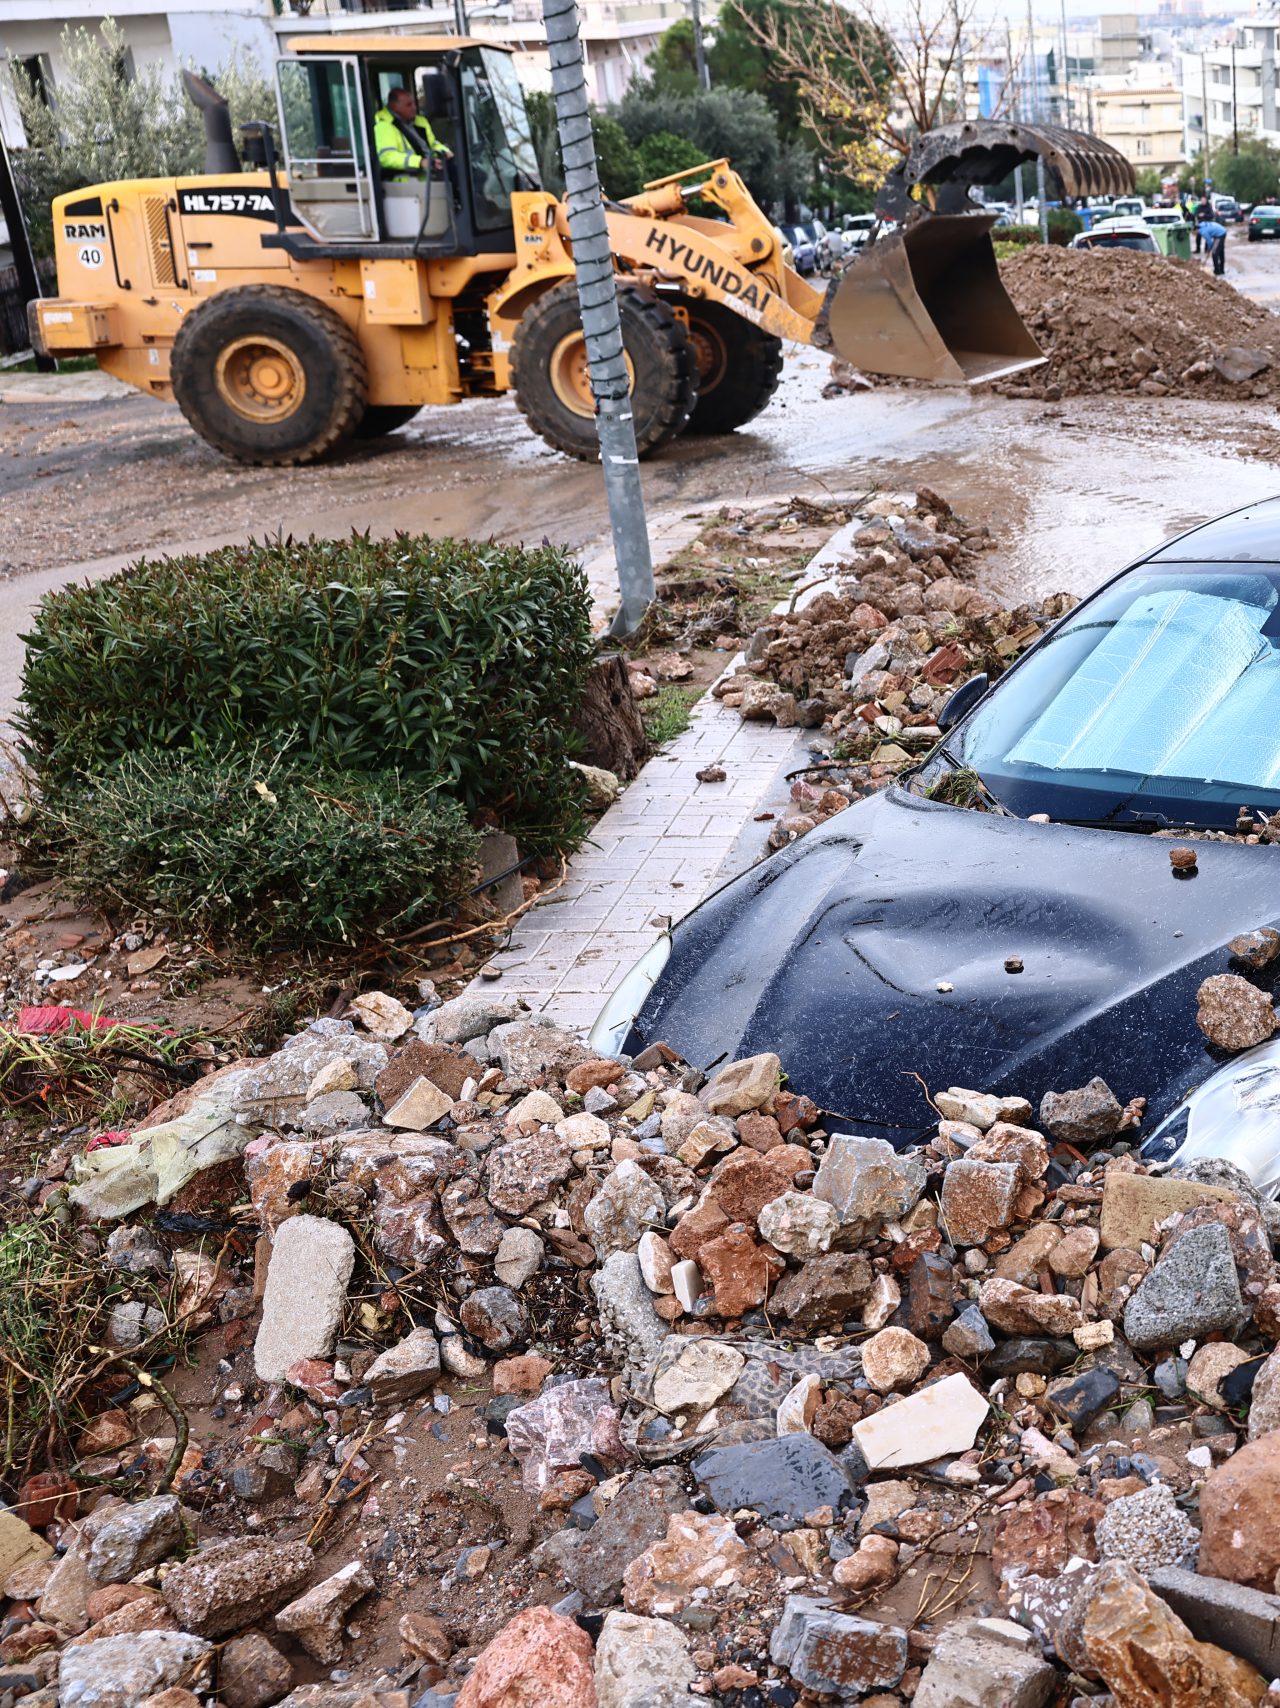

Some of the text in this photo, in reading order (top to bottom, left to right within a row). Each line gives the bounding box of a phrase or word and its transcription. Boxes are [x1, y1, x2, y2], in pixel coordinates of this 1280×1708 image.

[183, 195, 275, 212] HL757-7A
[64, 224, 106, 239] RAM
[80, 249, 101, 264] 40
[645, 227, 772, 313] HYUNDAI
